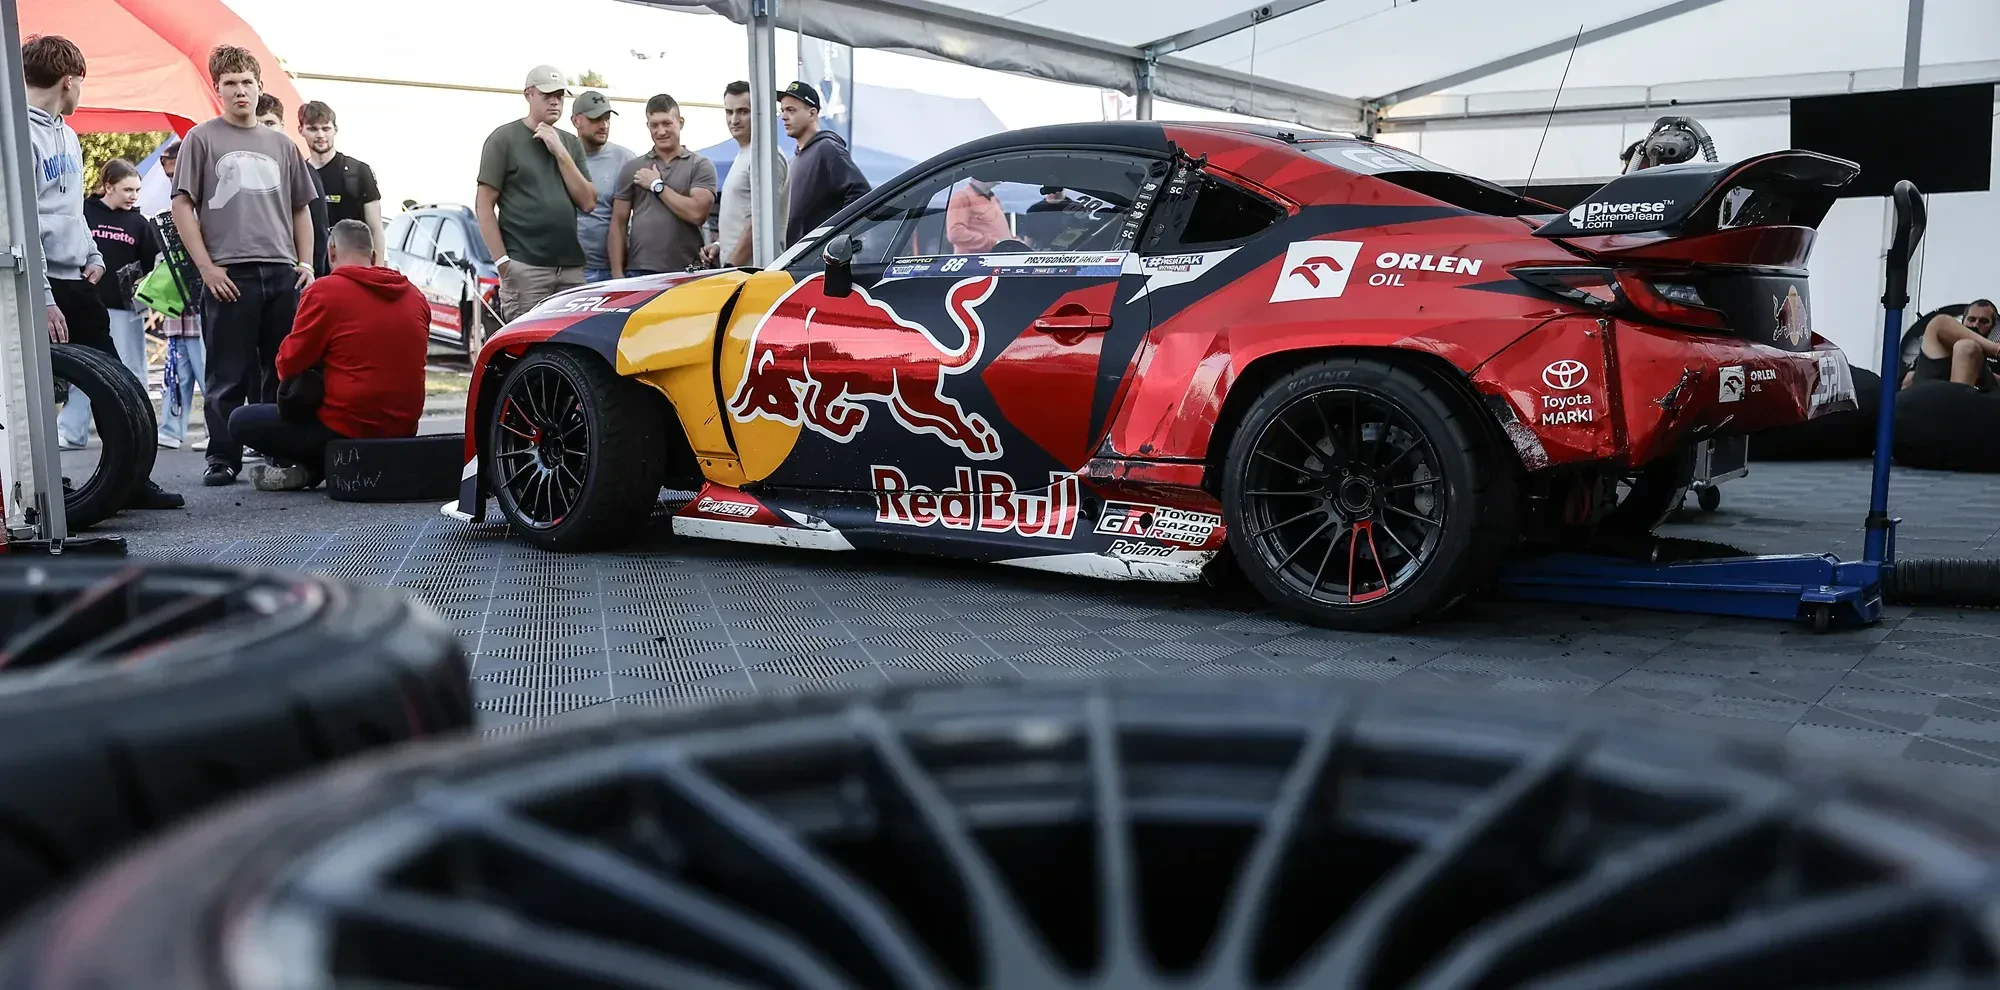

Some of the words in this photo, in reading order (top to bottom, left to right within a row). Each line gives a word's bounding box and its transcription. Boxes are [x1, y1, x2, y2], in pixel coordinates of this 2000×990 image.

[1169, 186, 1183, 195] SC
[1134, 201, 1148, 211] SC
[1588, 201, 1665, 214] Diverse
[1586, 211, 1664, 222] ExtremeTeam
[1585, 221, 1613, 229] .com
[91, 229, 136, 246] runette
[1121, 229, 1135, 239] SC
[1375, 252, 1483, 276] ORLEN
[1368, 273, 1405, 287] OIL
[1750, 369, 1777, 382] ORLEN
[1750, 384, 1763, 393] OIL
[1541, 393, 1592, 410] Toyota
[1542, 408, 1593, 426] MARKI
[711, 502, 759, 517] WISEFAB
[870, 464, 974, 532] Red
[975, 470, 1079, 541] Bull
[1099, 514, 1150, 535] GR
[1159, 508, 1220, 526] TOYOTA
[1155, 519, 1212, 535] GAZOO
[1150, 528, 1205, 546] Racing
[1109, 540, 1177, 559] Poland
